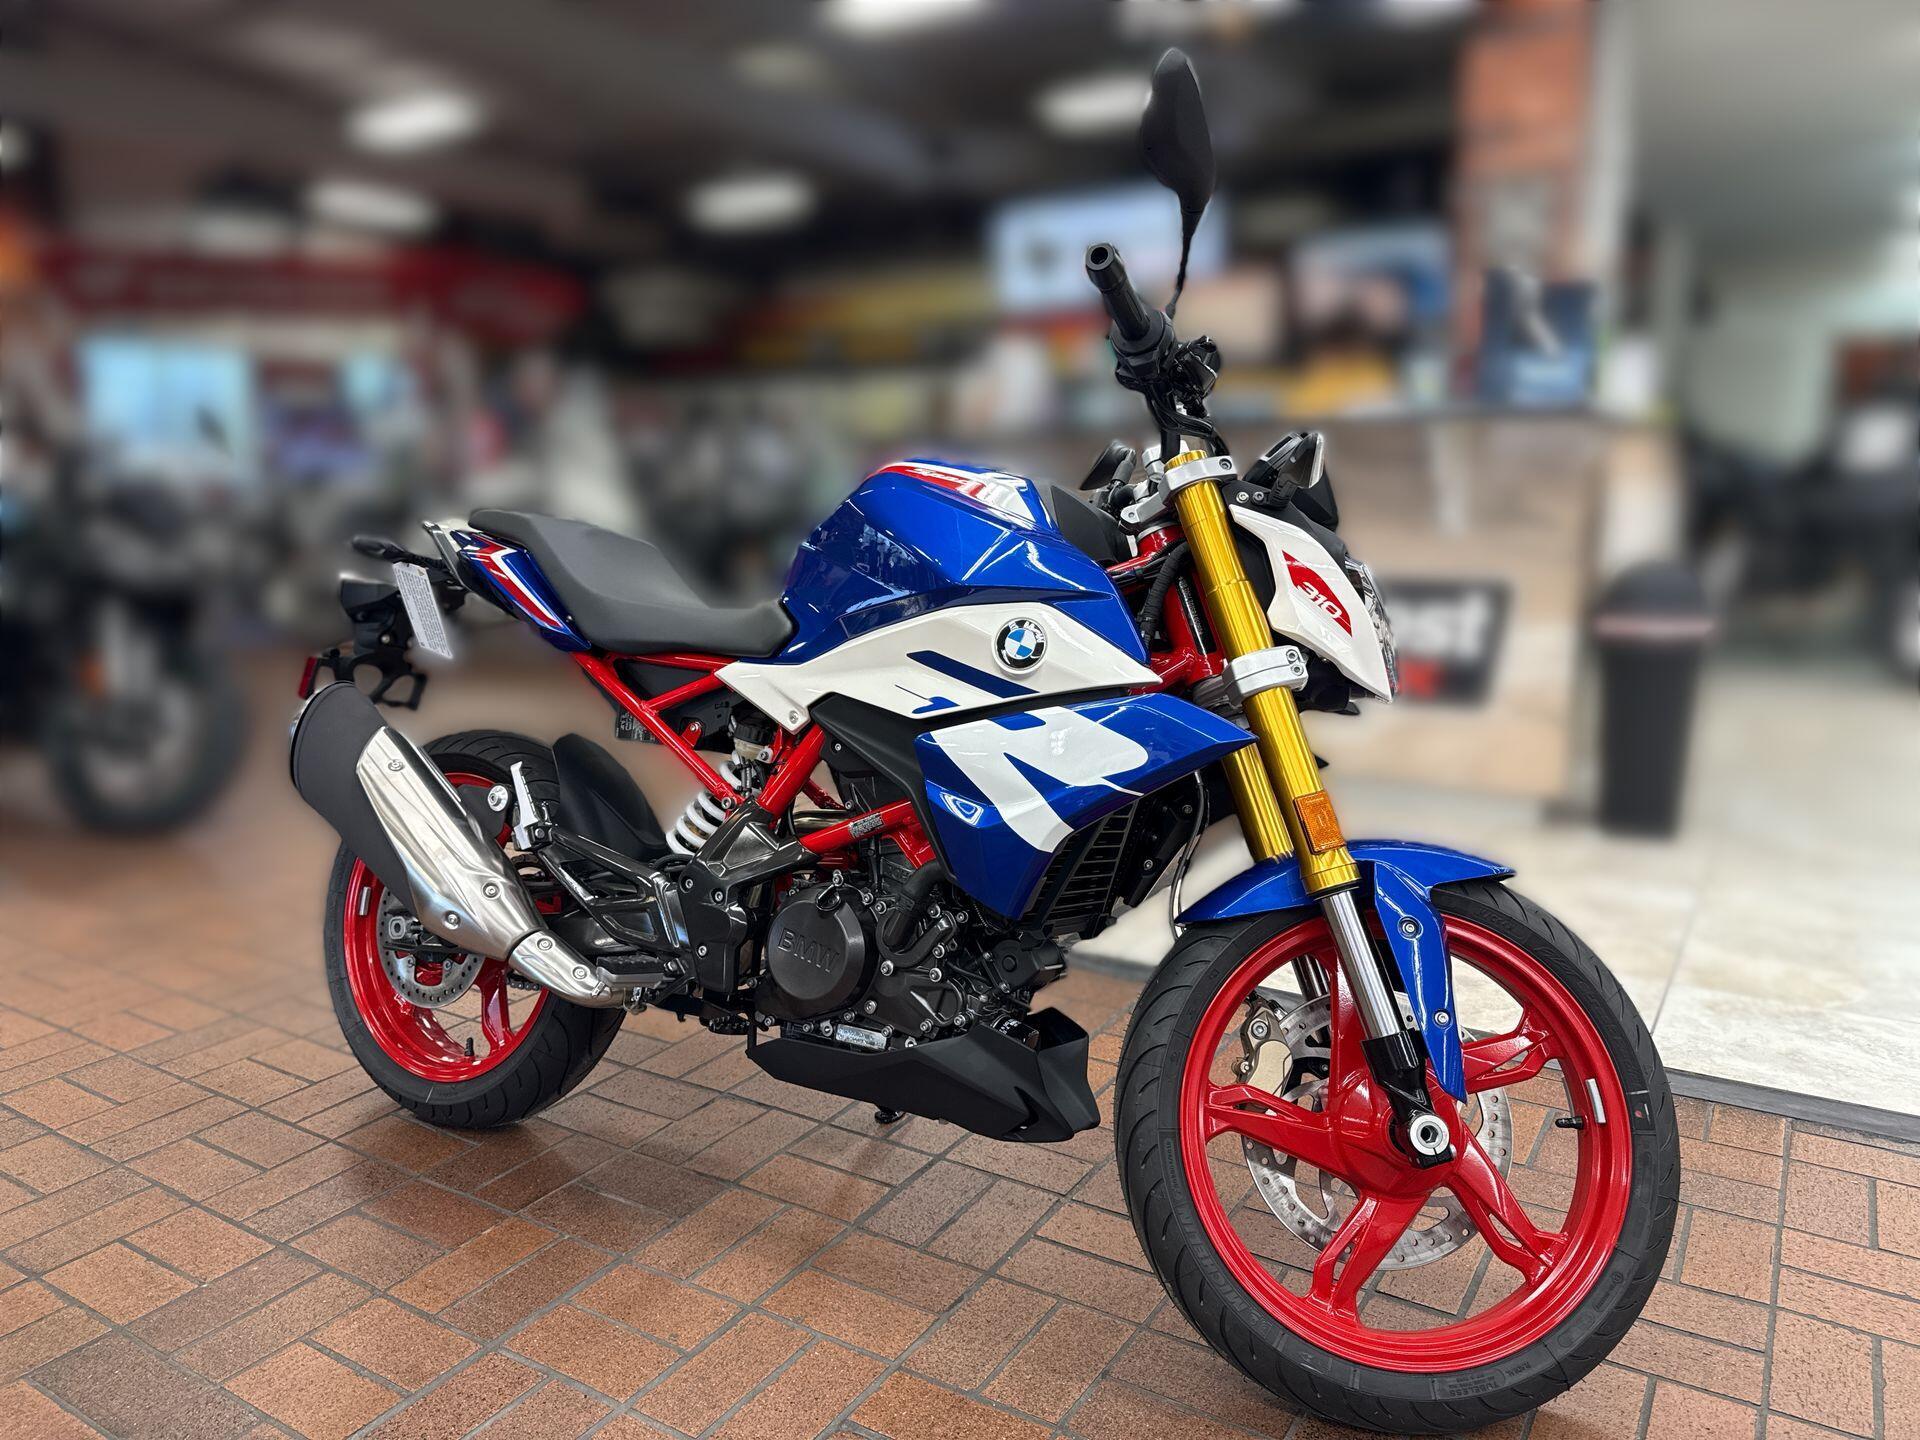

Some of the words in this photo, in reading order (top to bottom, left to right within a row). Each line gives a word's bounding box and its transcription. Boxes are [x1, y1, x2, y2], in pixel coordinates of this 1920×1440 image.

[1297, 581, 1343, 619] 310
[777, 927, 840, 973] BMW
[1174, 1201, 1249, 1312] MICHELIN
[1449, 1381, 1498, 1396] TUBELESS
